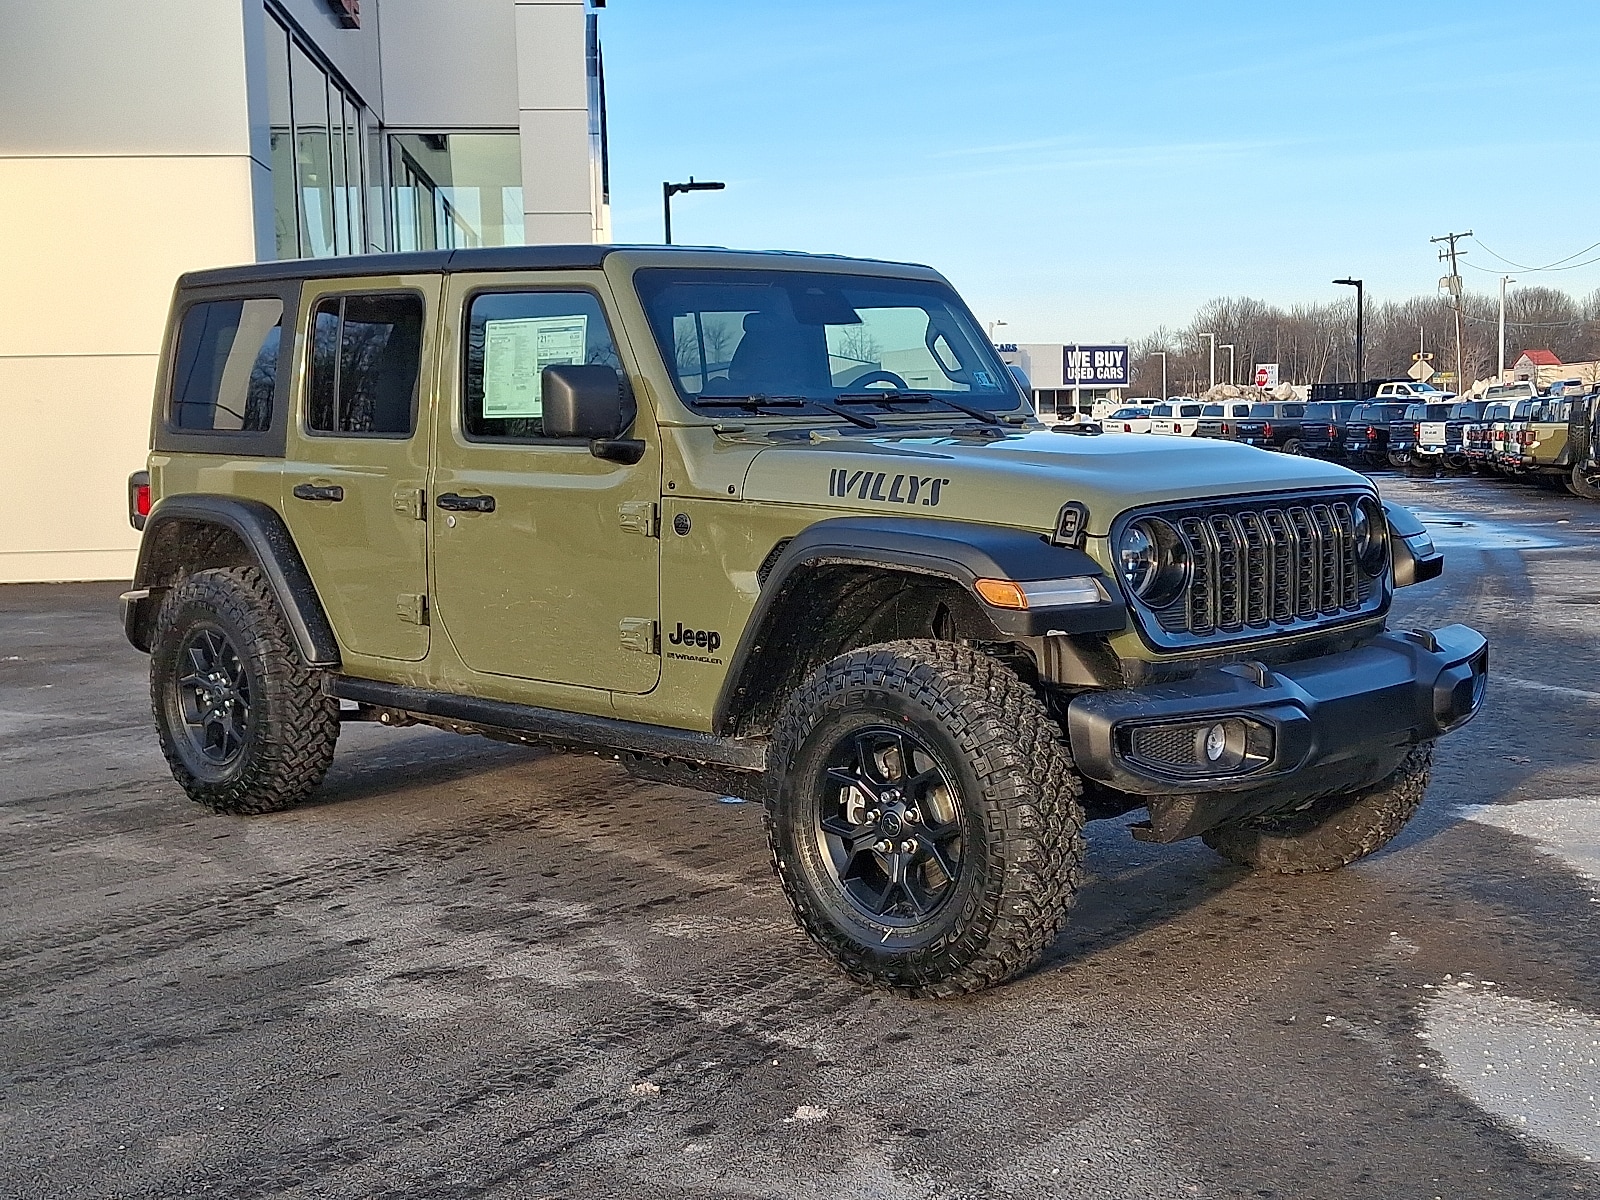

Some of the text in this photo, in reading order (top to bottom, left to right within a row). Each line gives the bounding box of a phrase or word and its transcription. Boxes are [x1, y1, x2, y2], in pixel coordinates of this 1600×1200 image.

[1067, 351, 1124, 368] WE BUY
[1067, 367, 1124, 380] USED CARS
[1255, 374, 1268, 383] STOP
[829, 468, 951, 507] WILLYS
[668, 622, 721, 653] Jeep
[675, 653, 723, 665] WRANGLER
